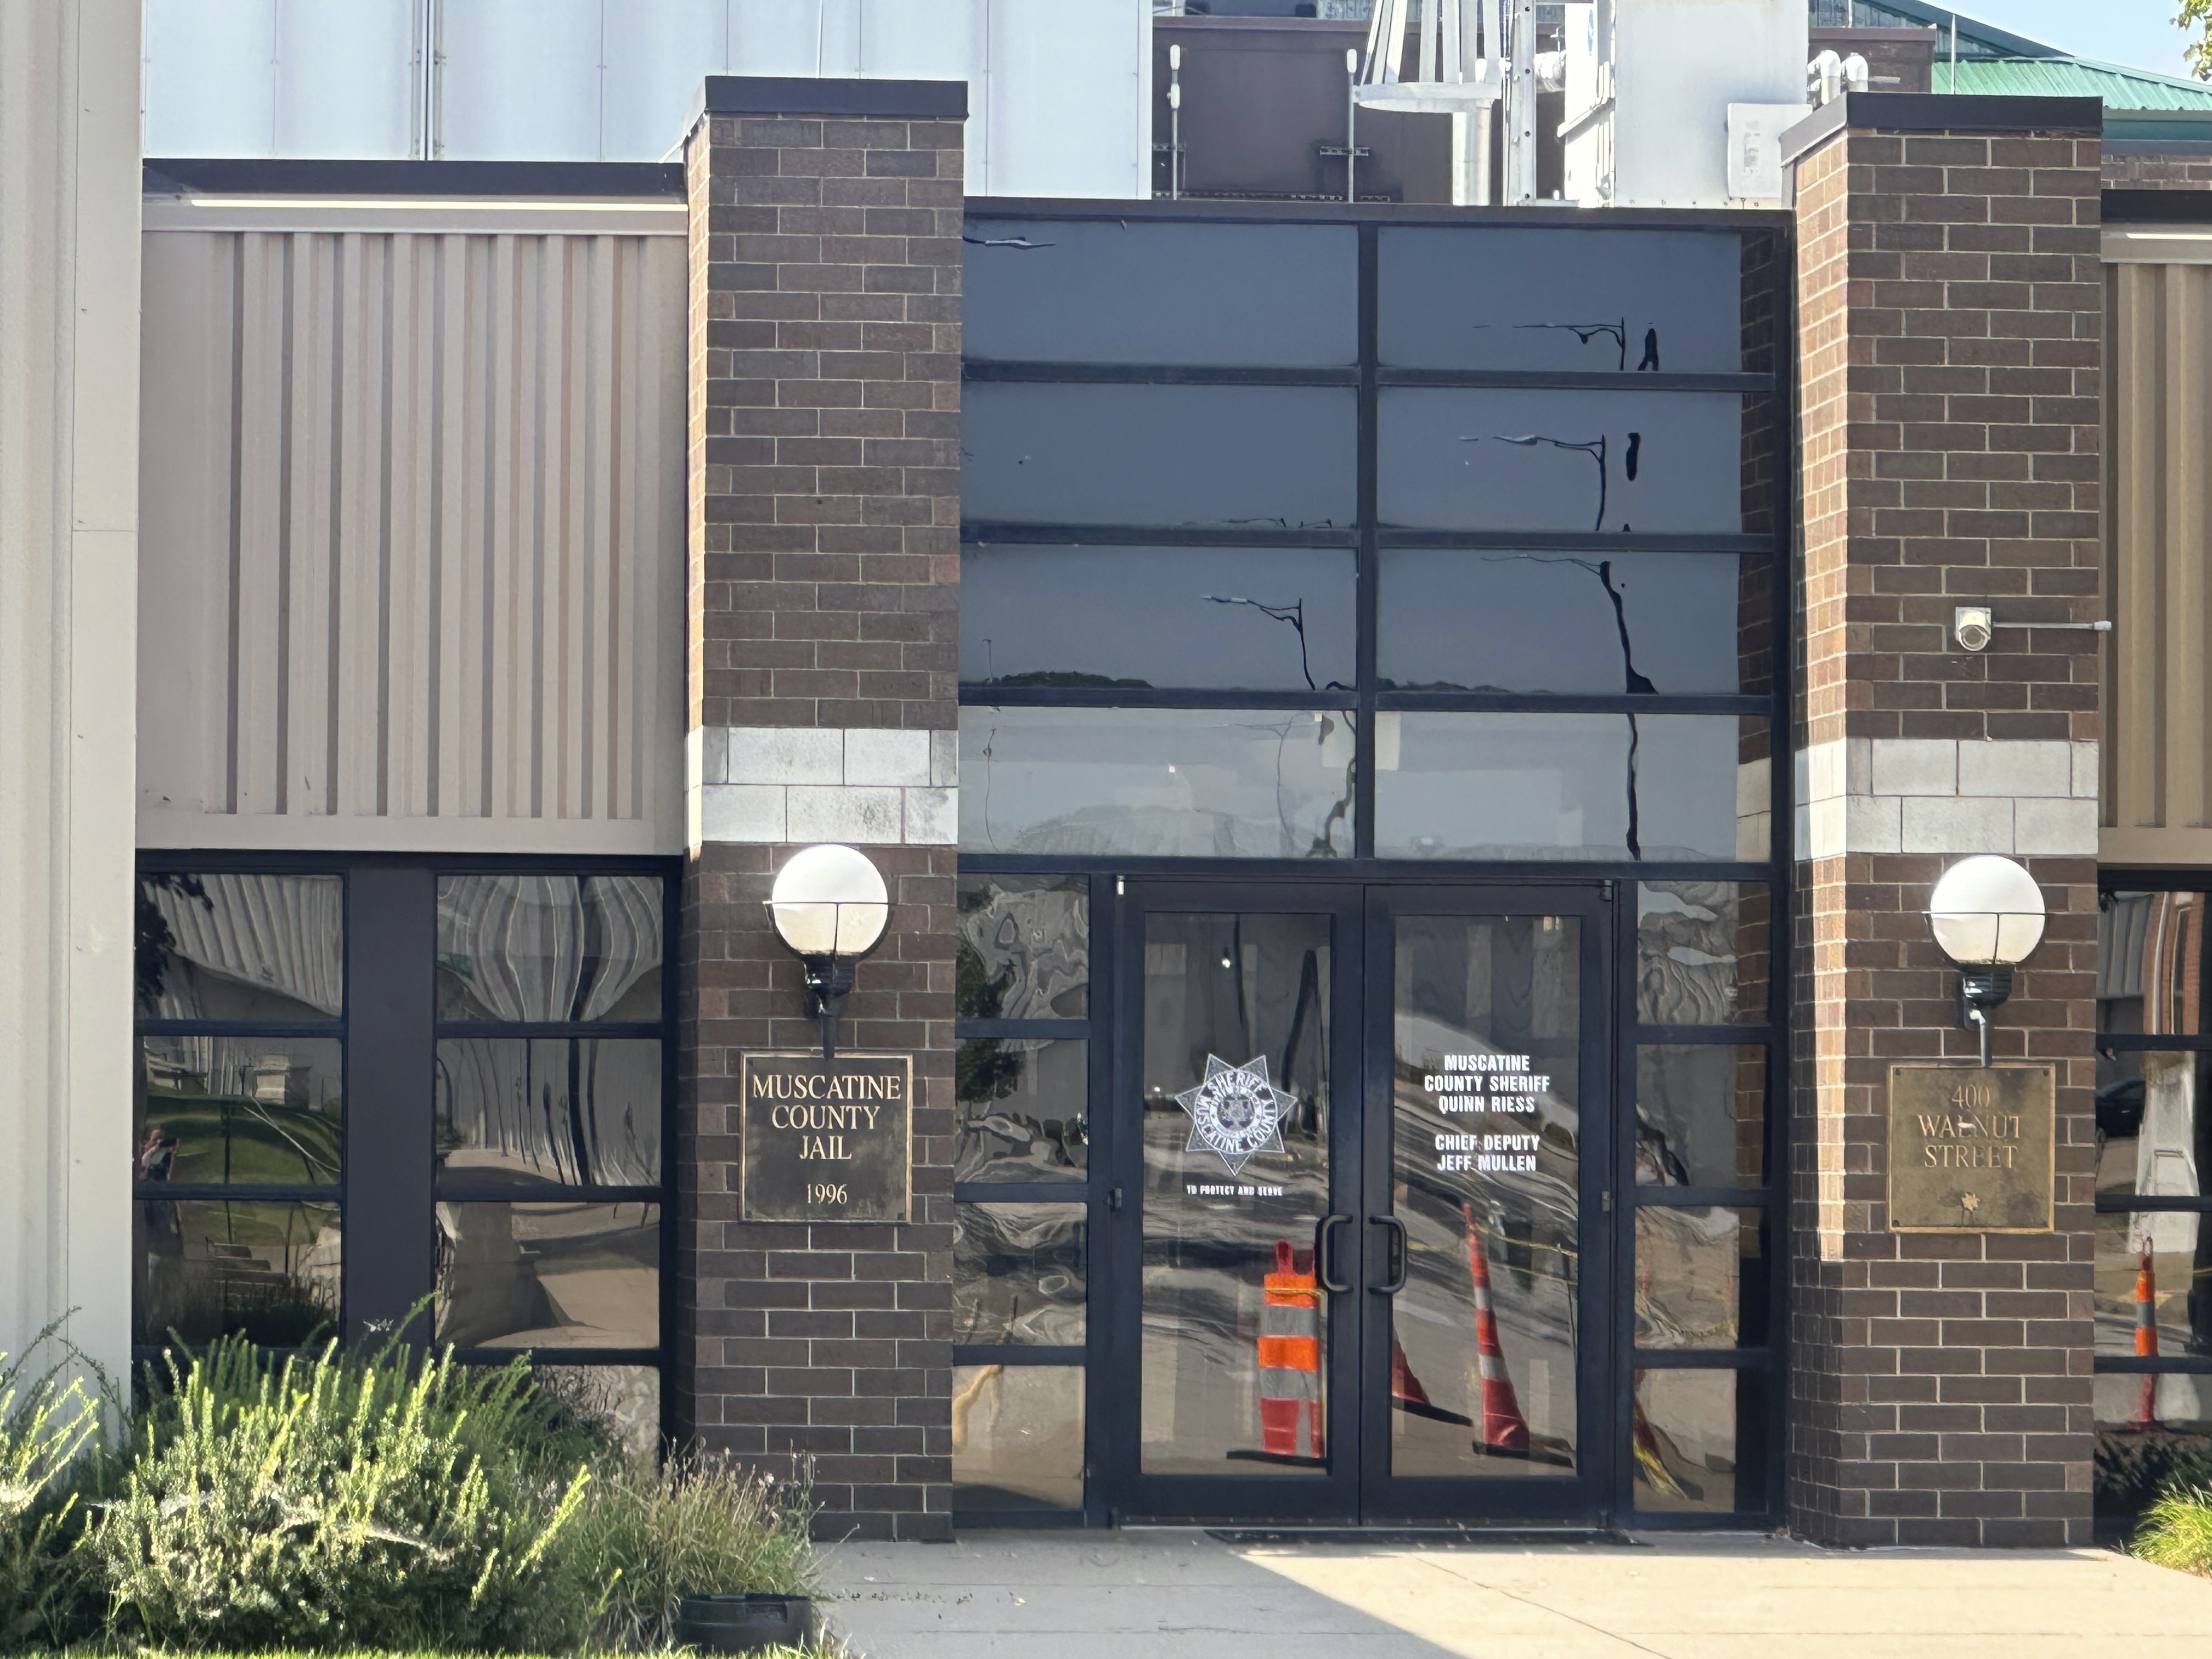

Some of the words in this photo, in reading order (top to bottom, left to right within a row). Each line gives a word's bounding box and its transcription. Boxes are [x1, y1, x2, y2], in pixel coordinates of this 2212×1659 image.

[1444, 1054, 1530, 1071] MUSCATINE
[753, 1074, 901, 1100] MUSCATINE
[1424, 1075, 1483, 1092] COUNTY
[1489, 1075, 1550, 1092] SHERIFF
[1438, 1096, 1485, 1114] QUINN
[1492, 1096, 1535, 1113] RIESS
[1951, 1085, 1990, 1109] 400
[771, 1104, 881, 1130] COUNTY
[1196, 1096, 1243, 1153] MUSCATINE
[1917, 1114, 2020, 1138] WALNUT
[799, 1135, 851, 1160] JAIL
[1435, 1134, 1477, 1150] CHIEF
[1483, 1135, 1541, 1151] DEPUTY
[1437, 1155, 1472, 1171] JEFF
[1478, 1155, 1537, 1171] MULLEN
[1924, 1144, 2018, 1168] STREET
[806, 1183, 848, 1205] 1996
[1187, 1184, 1197, 1194] TO
[1200, 1185, 1234, 1195] PROTECT
[1238, 1185, 1254, 1195] AND
